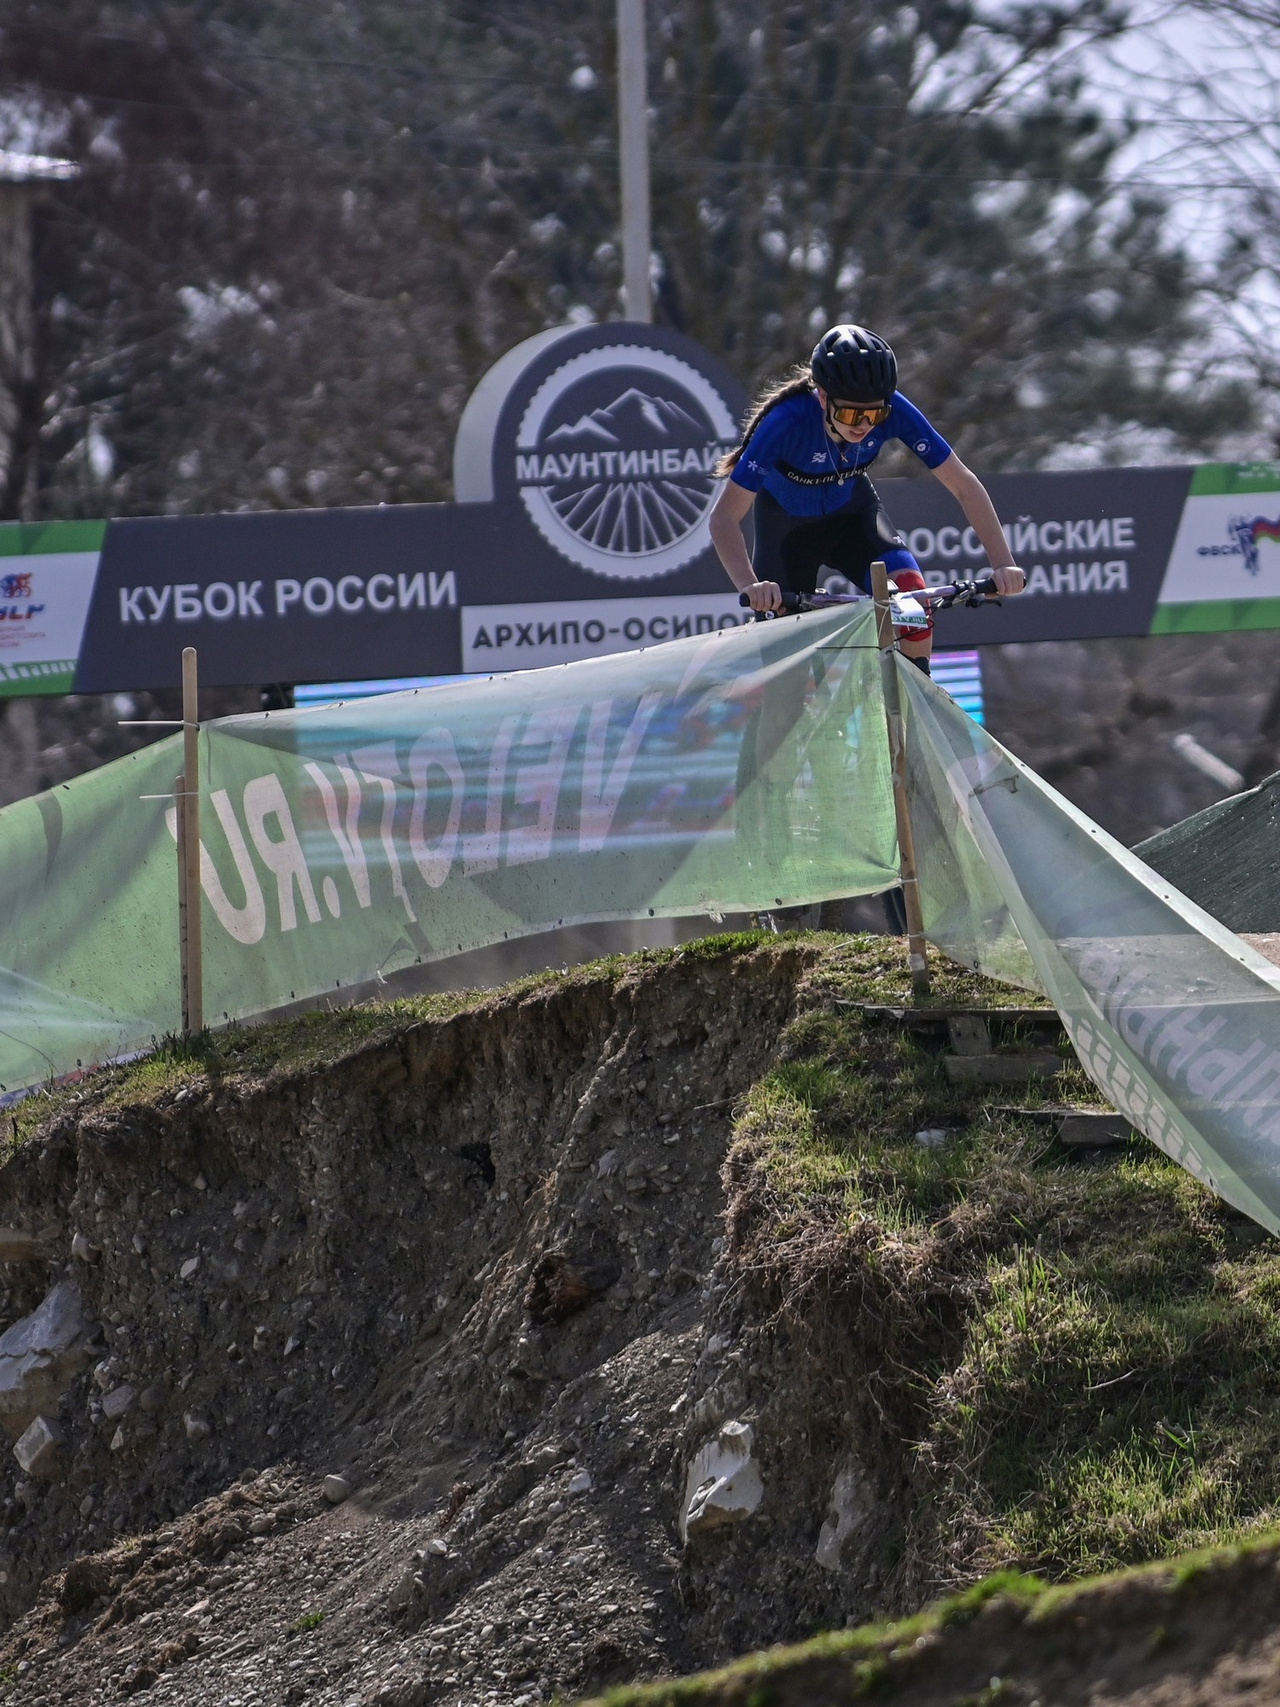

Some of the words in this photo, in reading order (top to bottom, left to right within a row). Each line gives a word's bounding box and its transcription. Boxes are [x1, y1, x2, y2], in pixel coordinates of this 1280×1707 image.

[516, 440, 733, 480] МАУНТИНБАЙ
[897, 515, 1135, 558] ОССЙСКИЕ
[119, 580, 263, 621] КУБОК
[275, 570, 457, 614] РОССИИ
